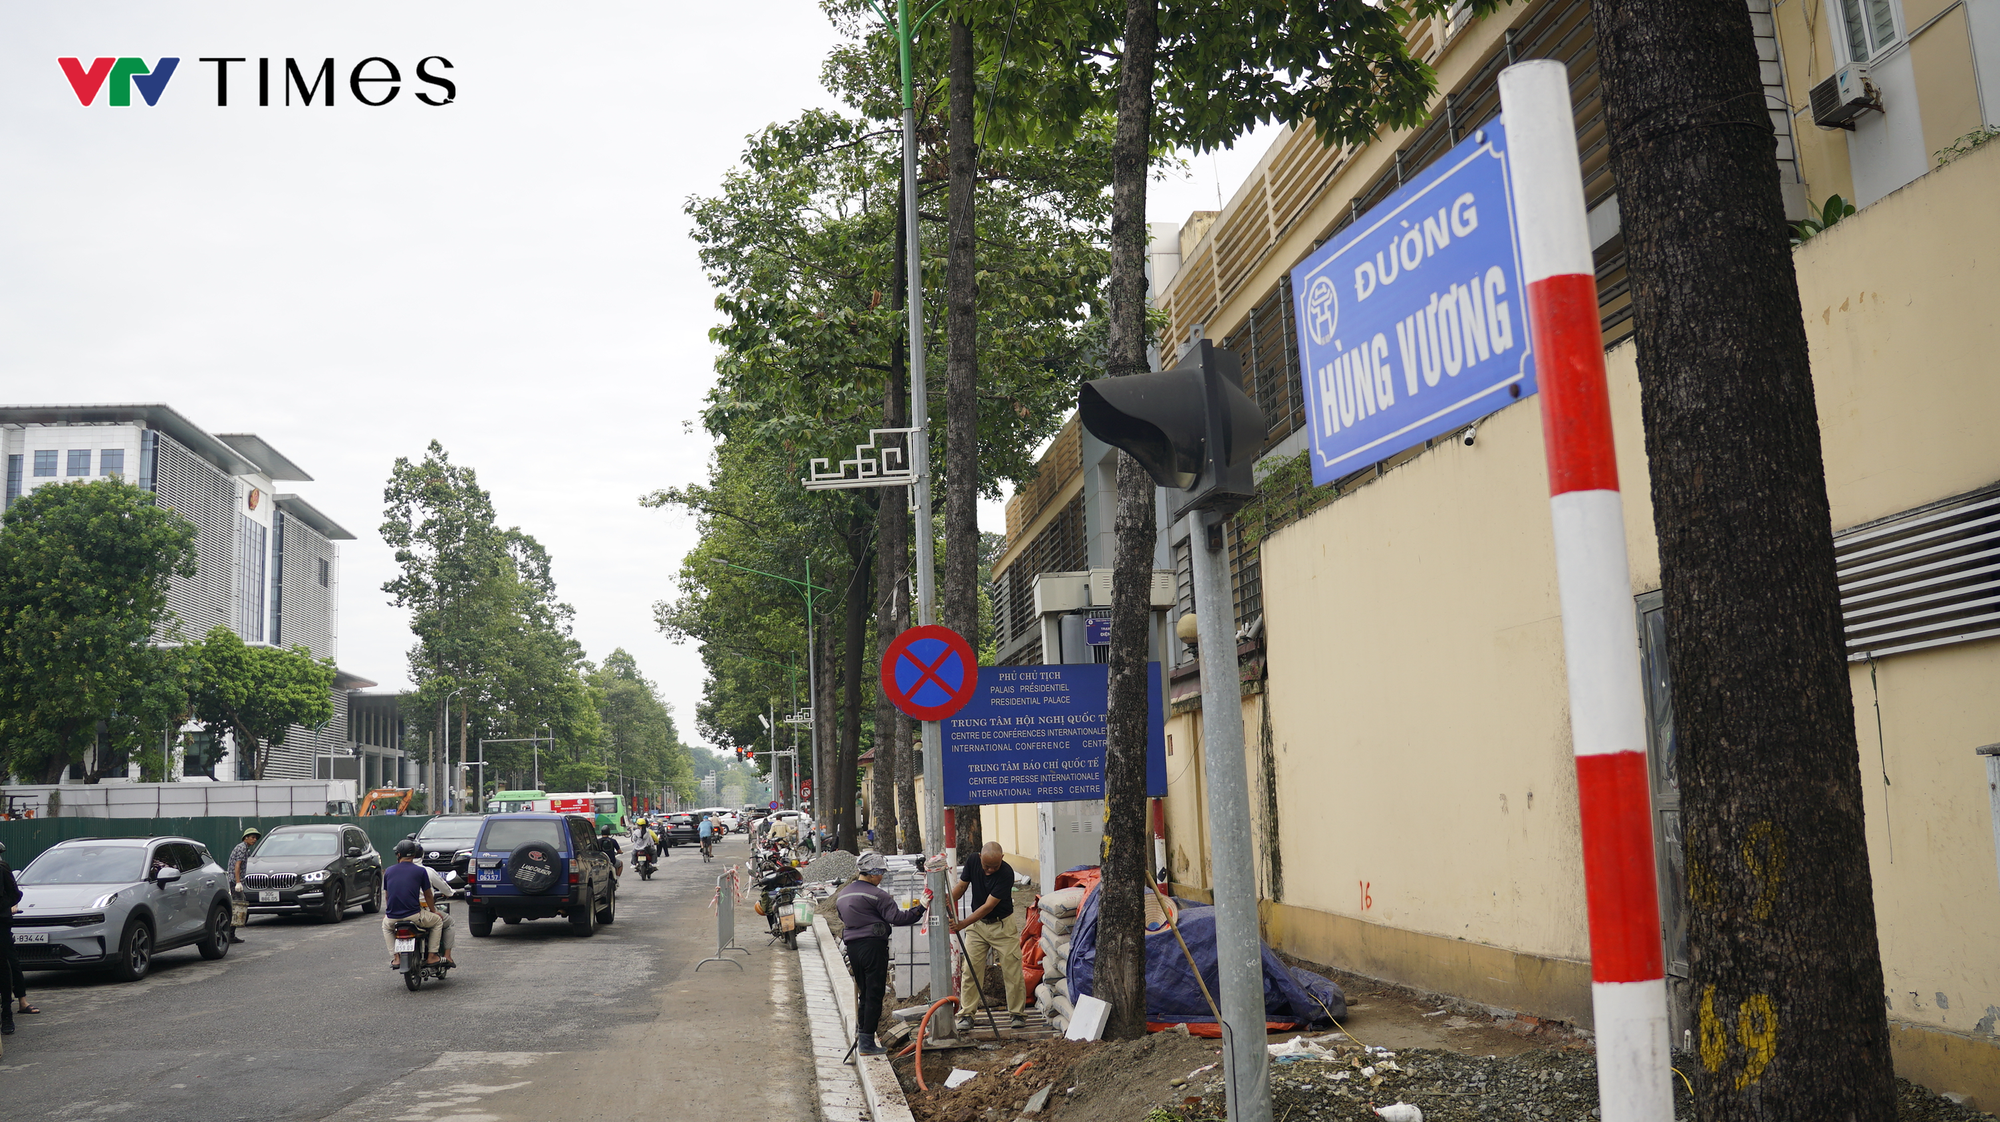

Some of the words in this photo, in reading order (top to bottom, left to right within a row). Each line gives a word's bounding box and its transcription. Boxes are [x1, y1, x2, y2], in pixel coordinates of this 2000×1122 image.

[1354, 191, 1479, 303] ĐƯỜNG
[1318, 332, 1395, 438] HÙNG
[1396, 265, 1514, 397] VƯƠNG
[999, 670, 1017, 681] PHỦ
[1019, 670, 1038, 681] CHỦ
[1039, 671, 1061, 682] TỊCH
[990, 685, 1015, 693] PALAIS
[1020, 682, 1069, 693] PRÉSIDENTIEL
[991, 697, 1041, 706] PRESIDENTIAL
[1043, 696, 1070, 704] PALACE
[951, 718, 987, 728] TRUNG
[989, 715, 1012, 726] TÂM
[1015, 714, 1034, 726] HỘI
[1038, 715, 1065, 726] NGHỊ
[1067, 711, 1096, 725] QUỐC
[951, 731, 980, 740] CENTRE
[982, 731, 992, 739] DE
[993, 728, 1046, 739] CONFÉRENCES
[1047, 726, 1108, 737] INTERNATIONALE
[951, 743, 1012, 752] INTERNATIONAL
[1015, 741, 1070, 750] CONFERENCE
[1082, 740, 1107, 748] CENTR
[968, 763, 999, 773] TRUNG
[1001, 760, 1020, 772] TÂM
[1022, 760, 1041, 770] BÁO
[1042, 758, 1059, 770] CHÍ
[1061, 757, 1086, 770] QUỐC
[1087, 756, 1100, 767] TẾ
[968, 776, 997, 785] CENTRE
[999, 776, 1009, 784] DE
[1010, 774, 1039, 783] PRESSE
[1040, 772, 1100, 783] INTERNATIONALE
[968, 788, 1032, 798] INTERNATIONAL
[1037, 786, 1064, 795] PRESS
[1069, 785, 1100, 794] CENTRE
[1359, 880, 1372, 910] 16
